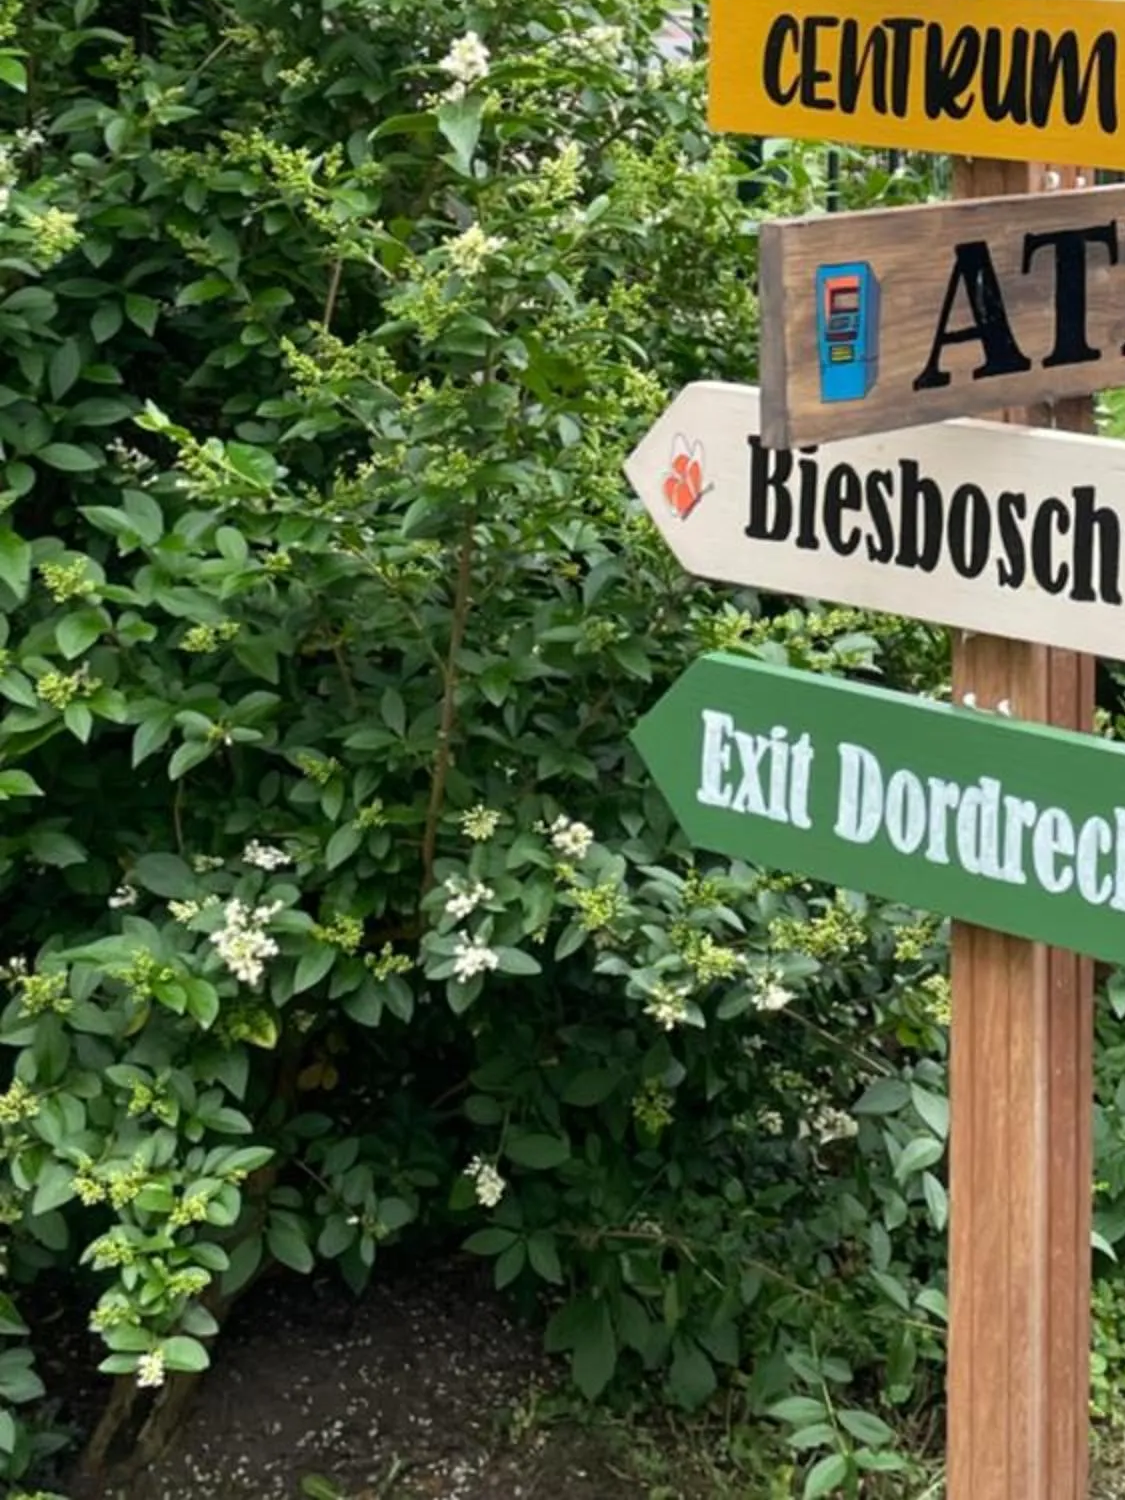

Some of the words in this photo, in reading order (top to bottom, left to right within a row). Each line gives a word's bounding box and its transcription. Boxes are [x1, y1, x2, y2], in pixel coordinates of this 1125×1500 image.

[762, 14, 1118, 135] CENTRUM
[744, 434, 1123, 605] Biesbosch
[696, 709, 814, 829] Exit
